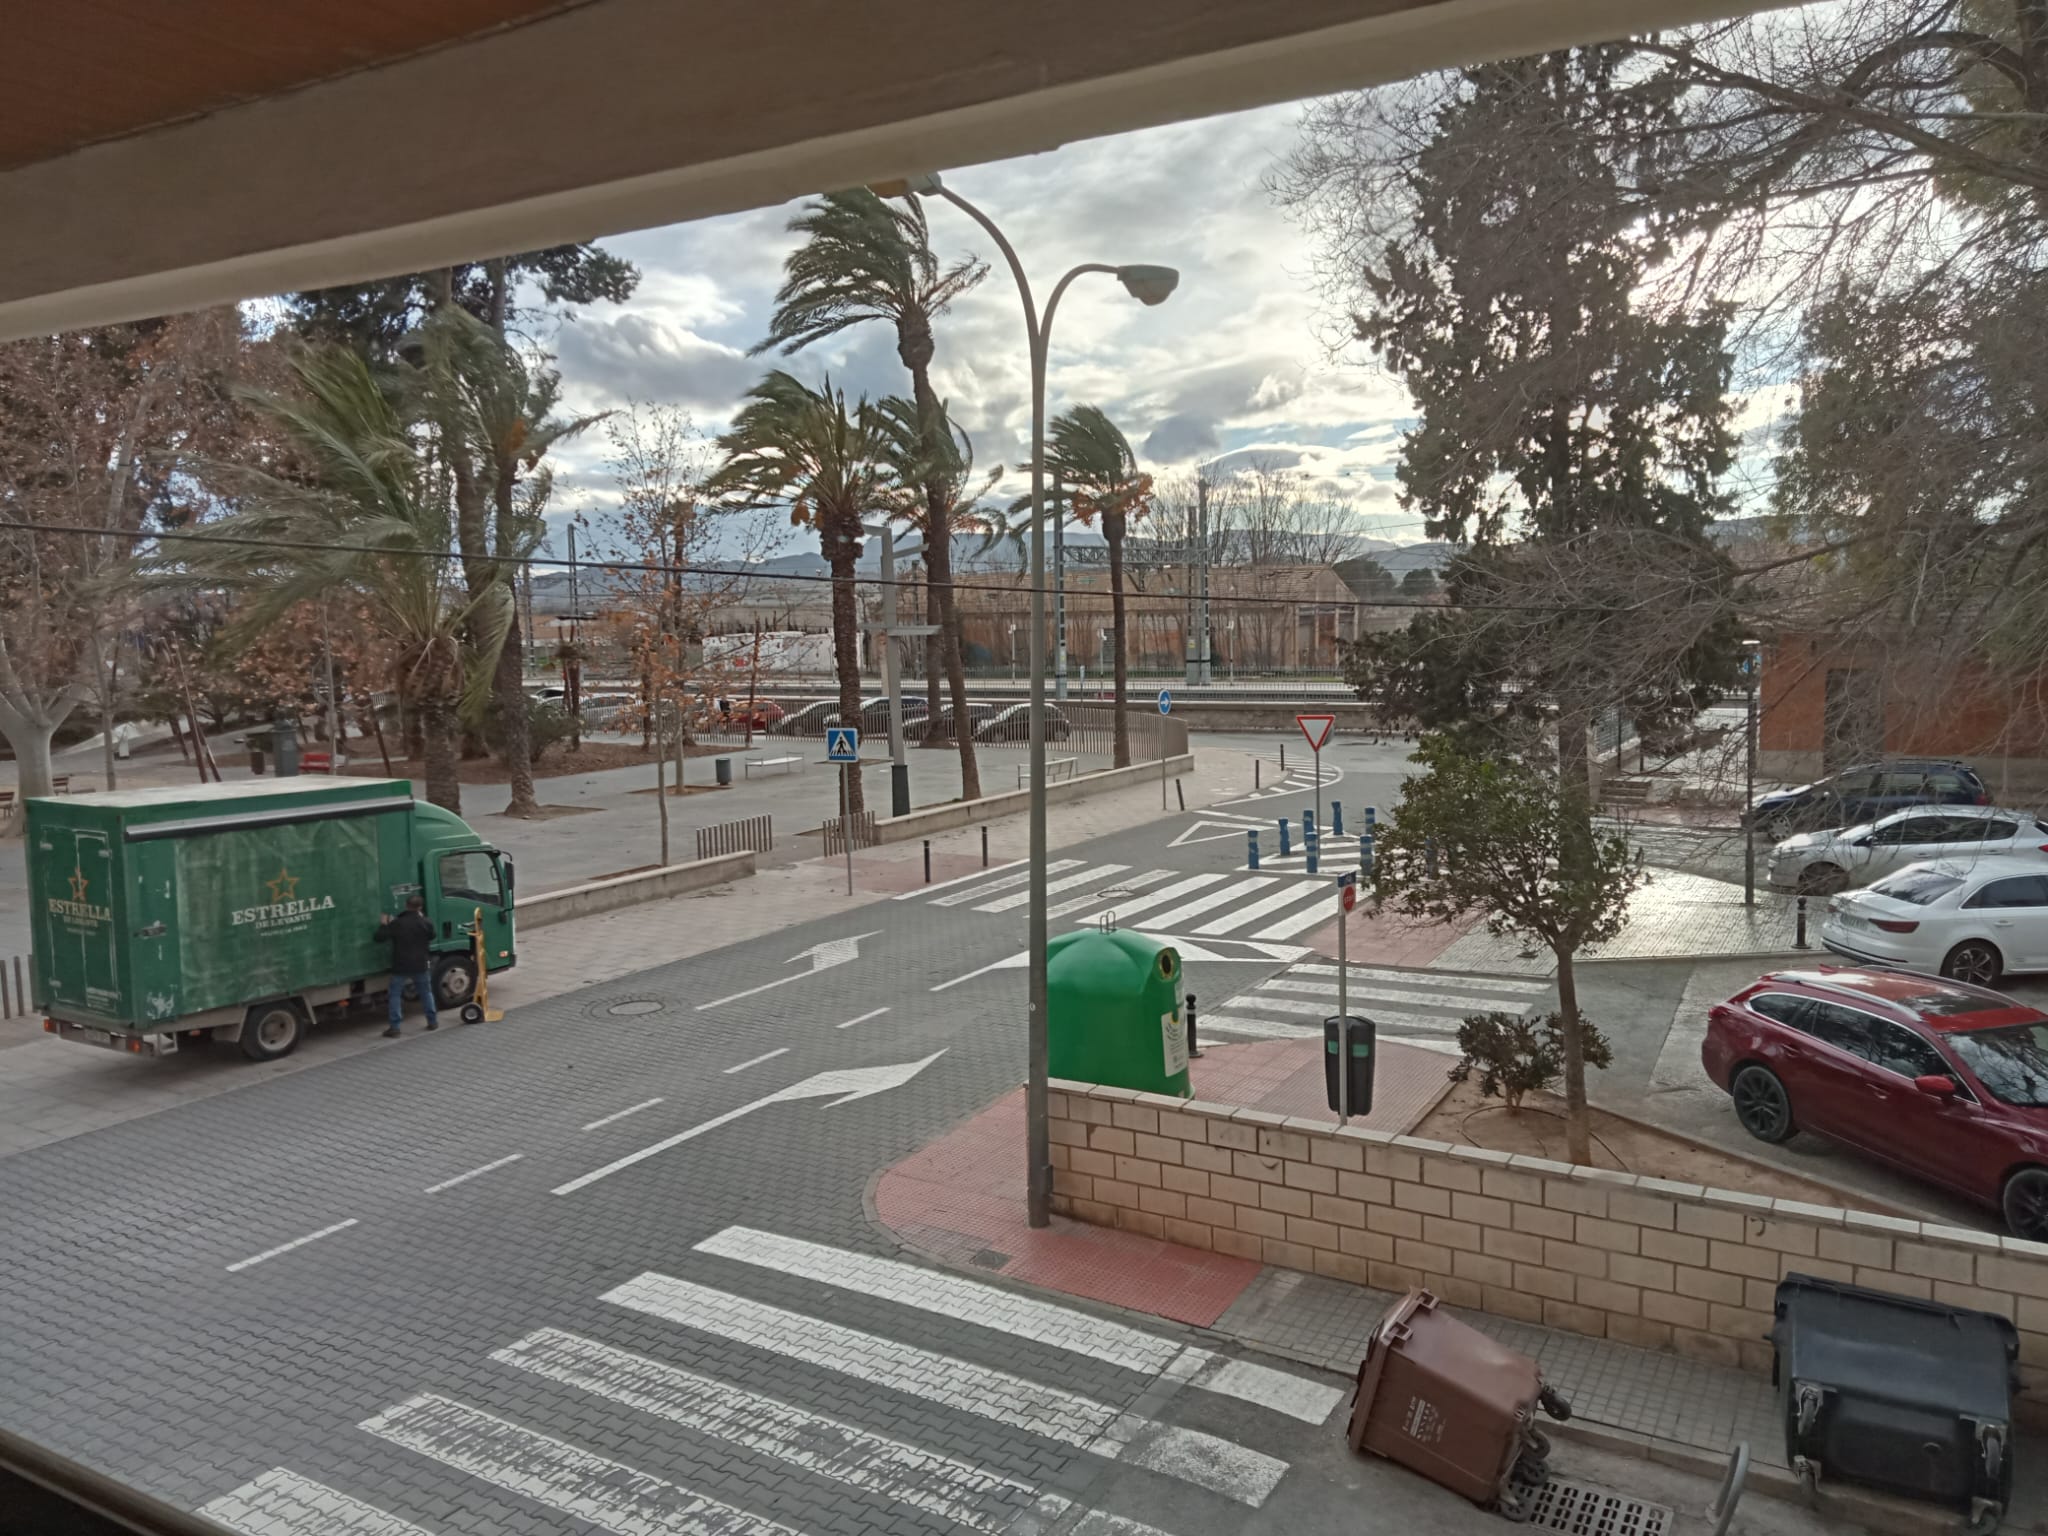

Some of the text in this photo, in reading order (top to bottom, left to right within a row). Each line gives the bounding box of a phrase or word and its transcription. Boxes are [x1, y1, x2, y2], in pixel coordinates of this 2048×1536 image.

[48, 898, 112, 921] ESTRELLA
[231, 895, 336, 926] ESTRELLA
[256, 913, 312, 929] DE LEVANTE
